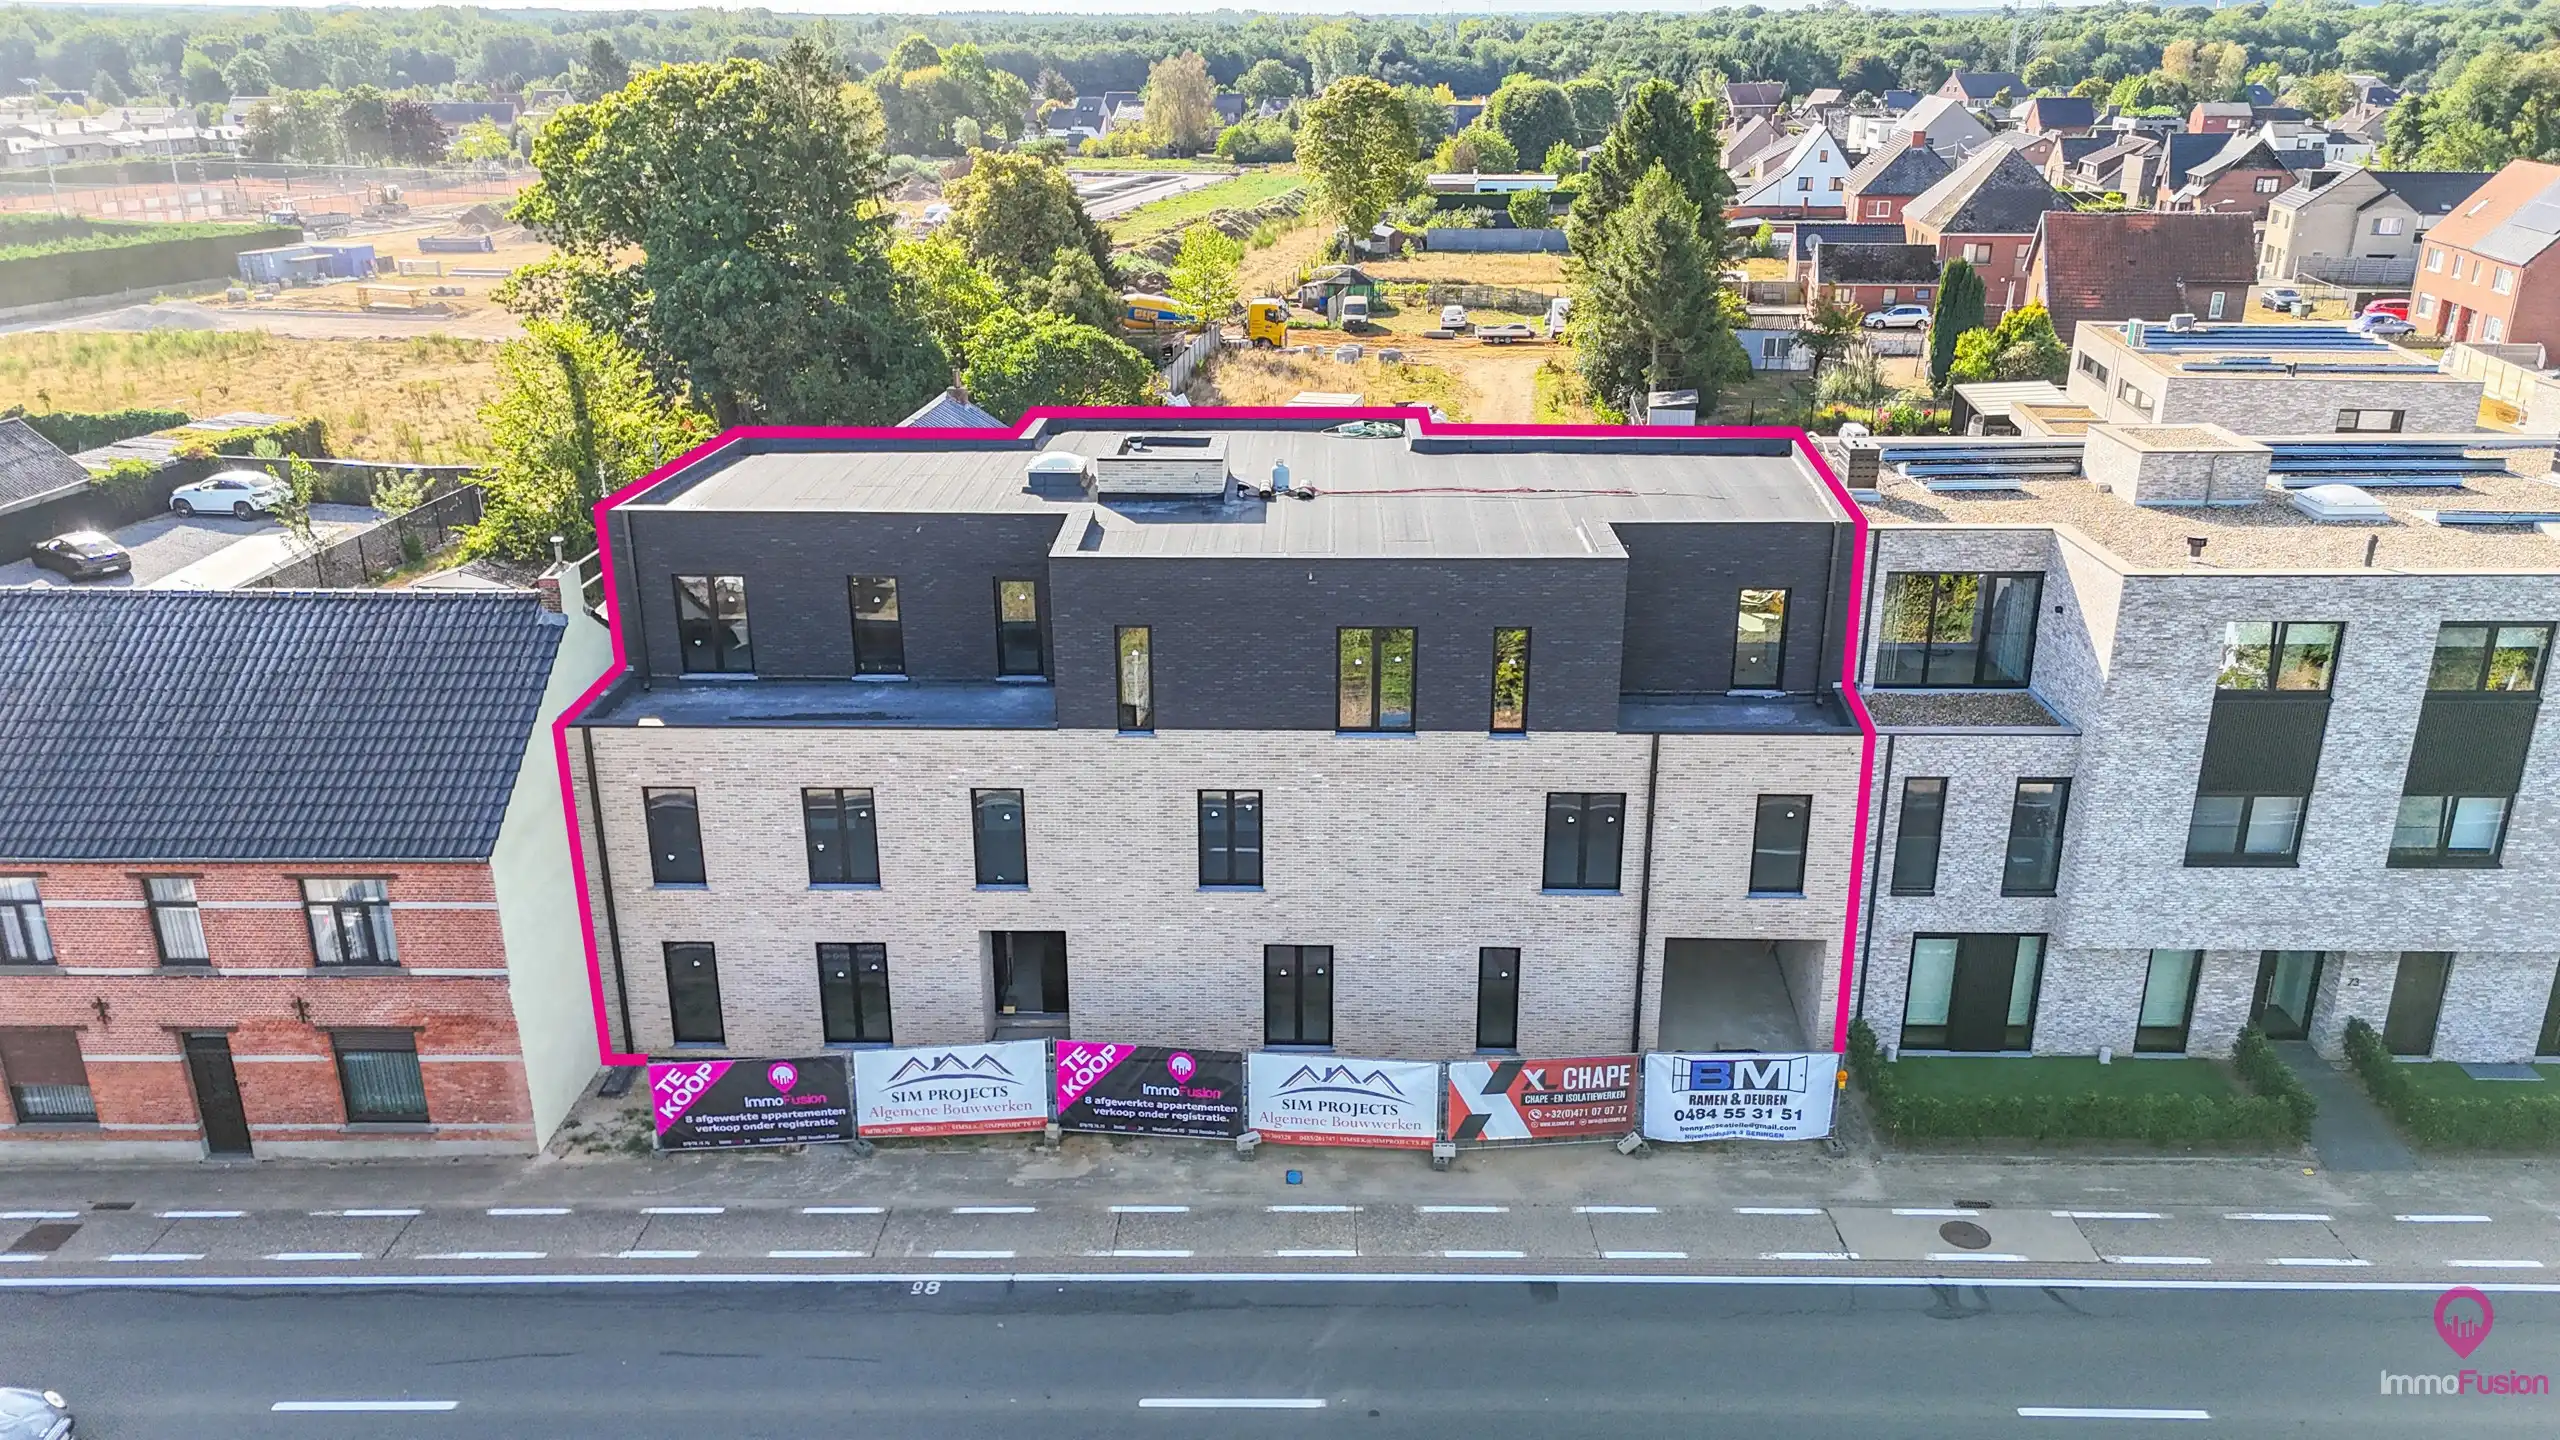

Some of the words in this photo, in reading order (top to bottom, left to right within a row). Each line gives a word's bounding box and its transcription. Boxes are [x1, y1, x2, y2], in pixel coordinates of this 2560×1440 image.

[1060, 1045, 1092, 1072] TE
[1061, 1044, 1116, 1097] KOOP
[1563, 1064, 1631, 1090] CHAPE
[1691, 1060, 1790, 1090] BM
[655, 1067, 687, 1094] TE
[659, 1063, 712, 1119] KOOP
[891, 1091, 923, 1103] SIM
[929, 1086, 1008, 1102] PROJECTS
[1142, 1083, 1221, 1099] ImmoFusion
[1525, 1095, 1548, 1104] CHAPE
[1565, 1090, 1626, 1102] ISOLATIEWERKEN
[1689, 1094, 1728, 1106] RAMEN
[1730, 1093, 1741, 1105] &
[1743, 1094, 1788, 1106] DEUREN
[744, 1093, 827, 1108] ImmoFusion
[1085, 1096, 1092, 1104] 8
[1094, 1097, 1154, 1109] afgewerkte
[1156, 1102, 1237, 1113] appartementen
[1282, 1099, 1312, 1112] SIM
[1318, 1101, 1398, 1117] PROJECTS
[685, 1115, 693, 1123] 8
[696, 1112, 759, 1124] afgewerkte
[761, 1108, 846, 1121] appartementen
[869, 1105, 938, 1121] Algemene
[943, 1100, 1032, 1115] Bouwwerken
[1093, 1107, 1136, 1119] verkoop
[1138, 1109, 1168, 1119] onder
[1171, 1112, 1230, 1123] registratie.
[1545, 1108, 1588, 1119] +32(0)471
[1591, 1107, 1601, 1116] 07
[1604, 1106, 1614, 1115] 07
[1617, 1105, 1628, 1114] 77
[1674, 1108, 1717, 1121] 0484
[1723, 1108, 1746, 1119] 55
[1752, 1108, 1773, 1119] 31
[1780, 1108, 1802, 1120] 51
[695, 1122, 740, 1133] verkoop
[743, 1121, 776, 1131] onder
[778, 1119, 839, 1131] registratie.
[1259, 1111, 1327, 1128] Algemene
[1332, 1116, 1422, 1130] Bouwwerken
